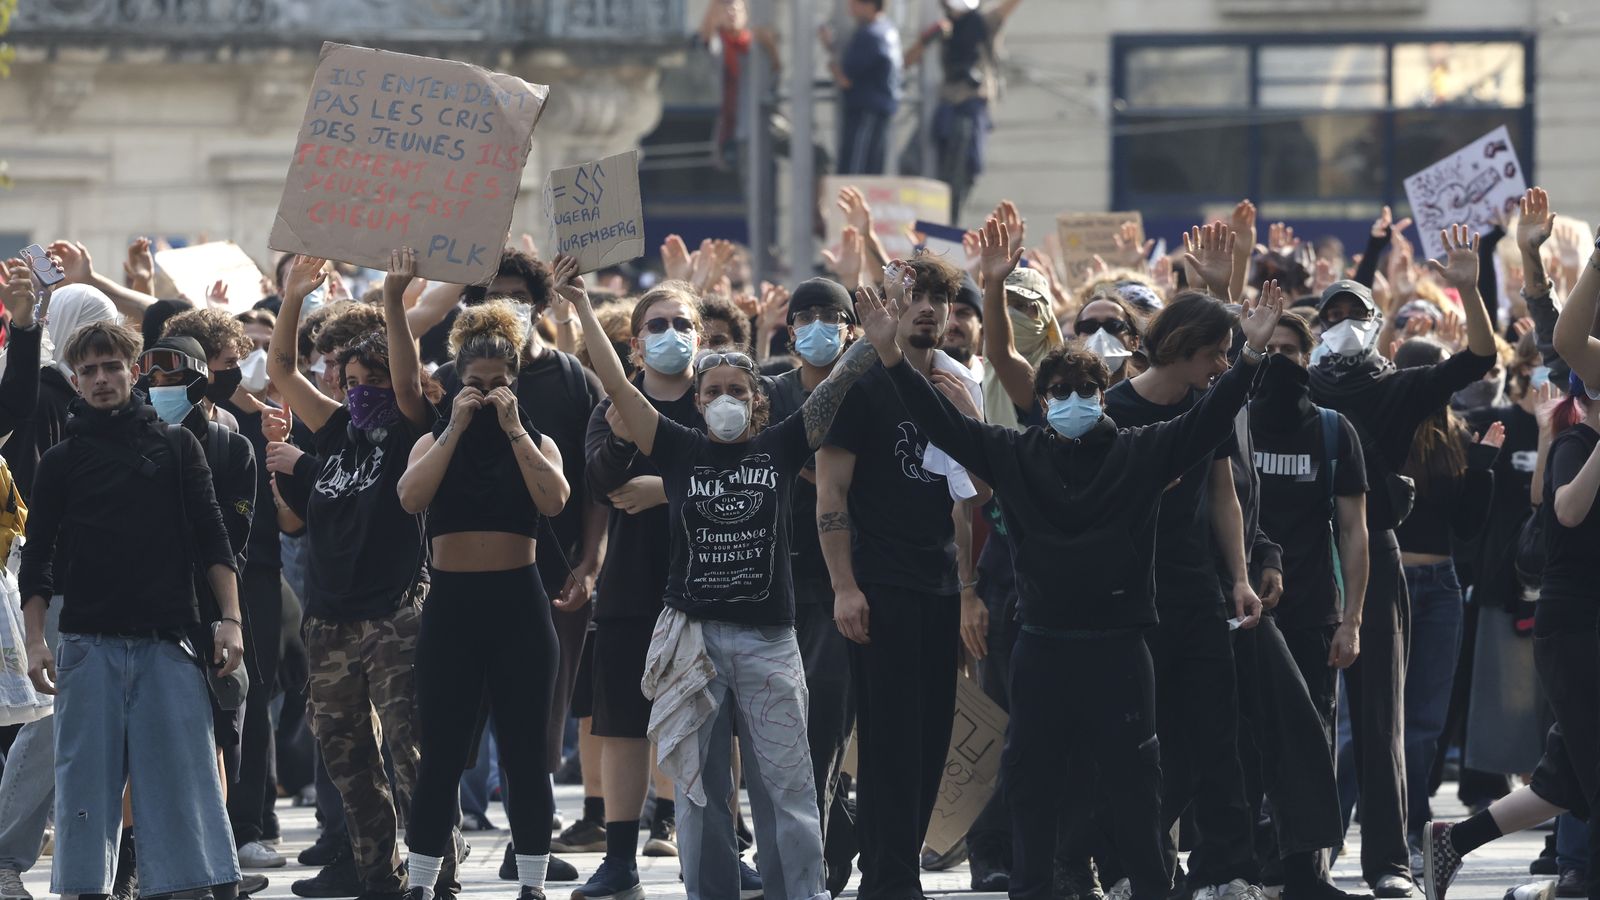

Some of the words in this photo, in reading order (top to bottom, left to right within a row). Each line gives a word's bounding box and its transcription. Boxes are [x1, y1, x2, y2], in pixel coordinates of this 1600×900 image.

[330, 68, 367, 87] ILS
[314, 89, 359, 117] PAS
[371, 99, 424, 126] LES
[438, 107, 495, 134] CRIS
[310, 118, 356, 143] DES
[367, 127, 466, 161] JEUNES
[476, 143, 521, 172] ILS
[297, 143, 429, 184] FERMENT
[444, 168, 503, 199] LES
[308, 199, 411, 234] CHEUM
[1253, 452, 1311, 475] PUMA
[687, 475, 725, 498] JACK
[714, 501, 745, 512] No.7
[696, 527, 767, 544] Tennessee
[698, 547, 764, 563] WHISKEY
